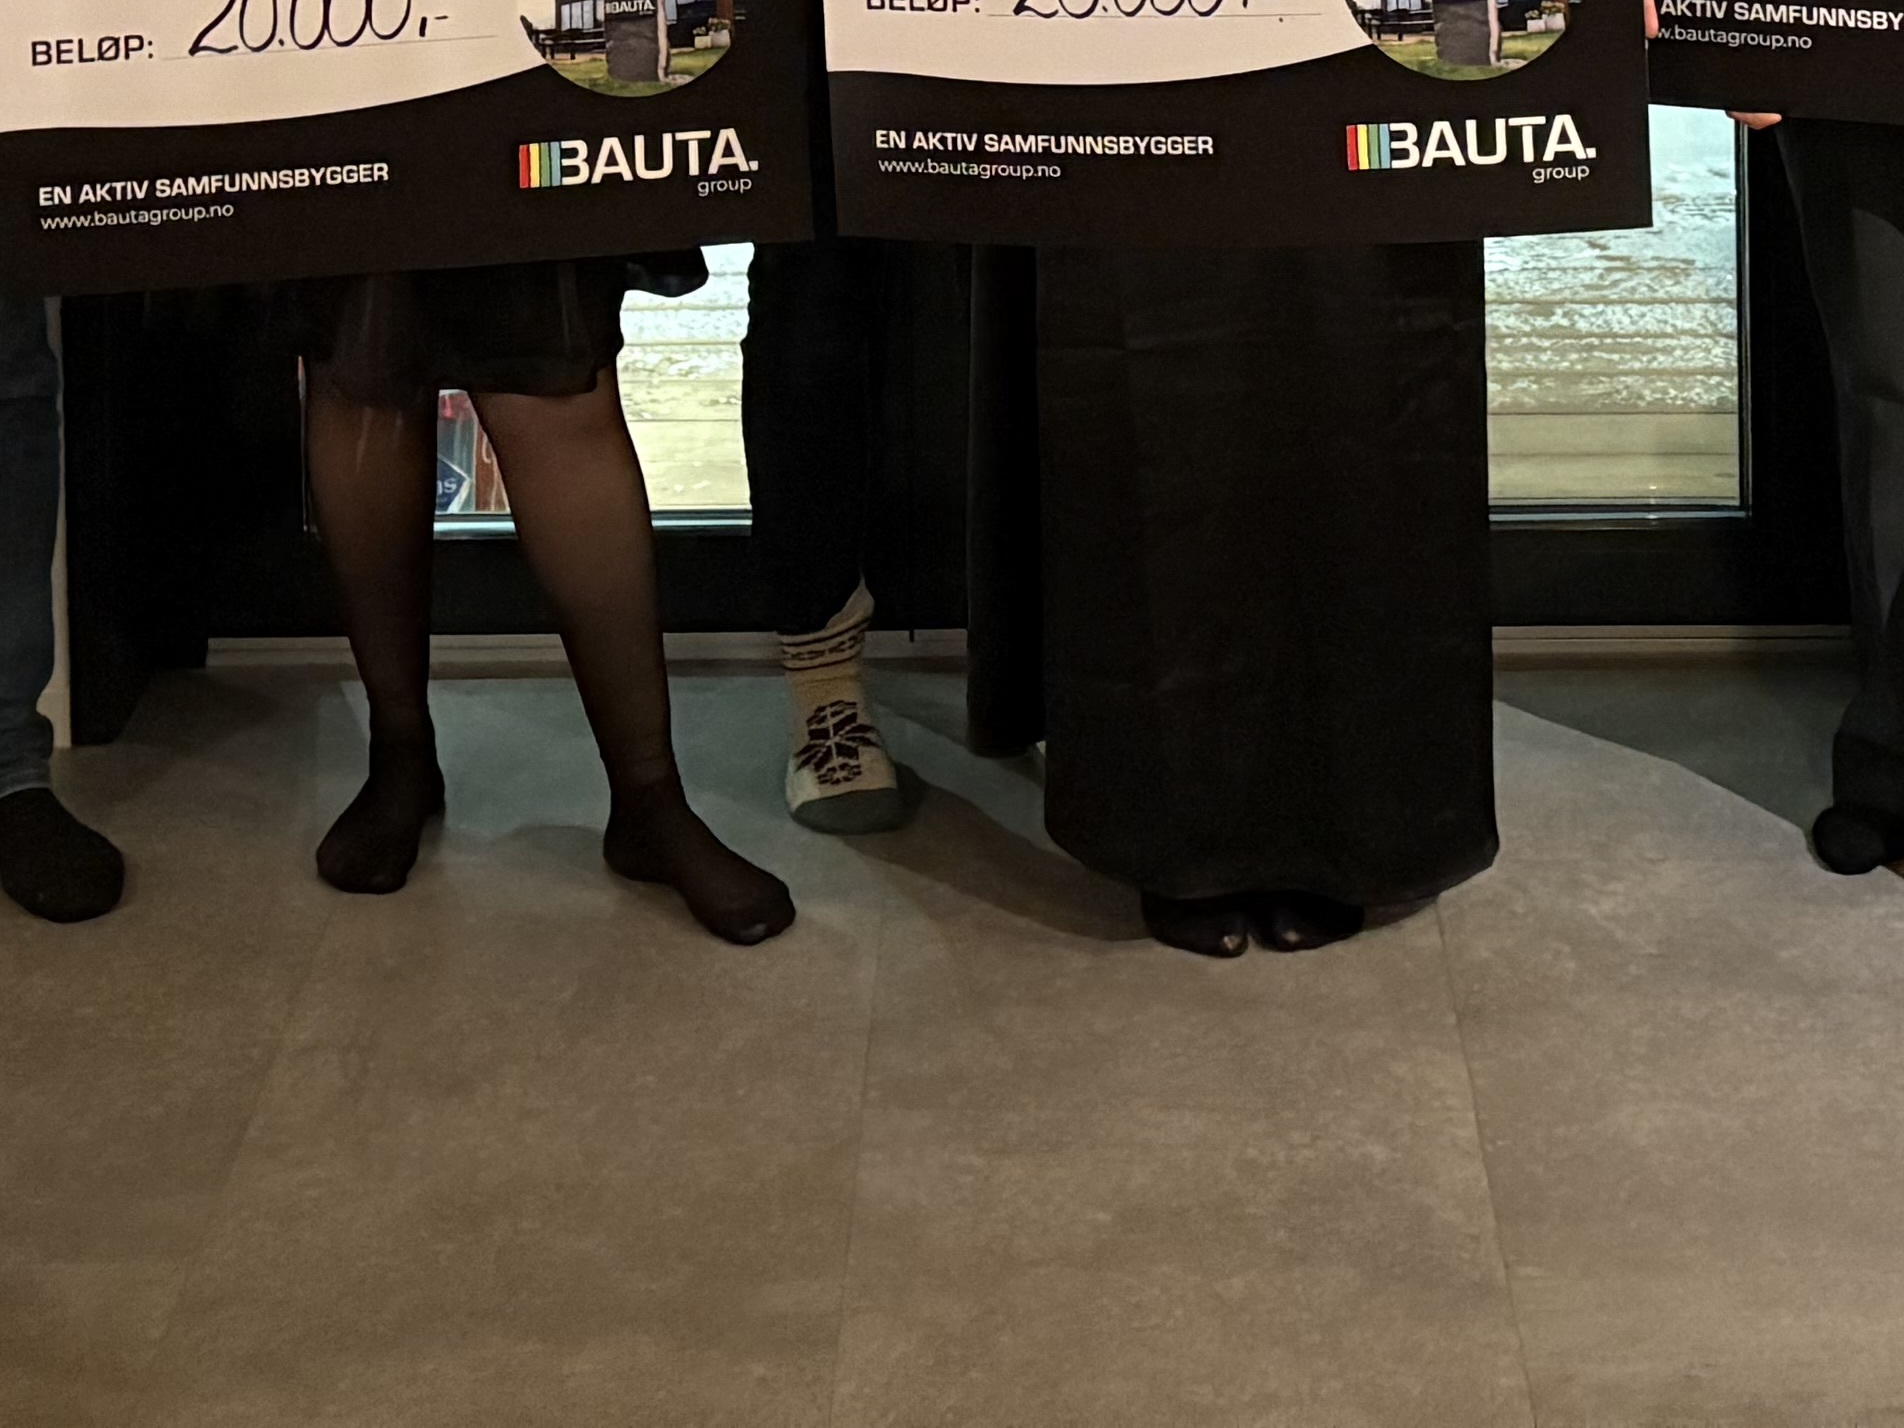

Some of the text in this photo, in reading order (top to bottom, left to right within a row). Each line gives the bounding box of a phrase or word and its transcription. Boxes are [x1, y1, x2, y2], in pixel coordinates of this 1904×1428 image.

[30, 34, 154, 67] BELØP:
[875, 129, 1214, 155] EN AKTIV SAMFUNNSBYGGER
[878, 158, 1062, 180] www.bautagroup.no
[1532, 165, 1590, 184] group
[38, 162, 389, 207] EN AKTIV SAMFUNNSBYGGER
[697, 178, 752, 197] group
[40, 204, 235, 230] www.bautagroup.no
